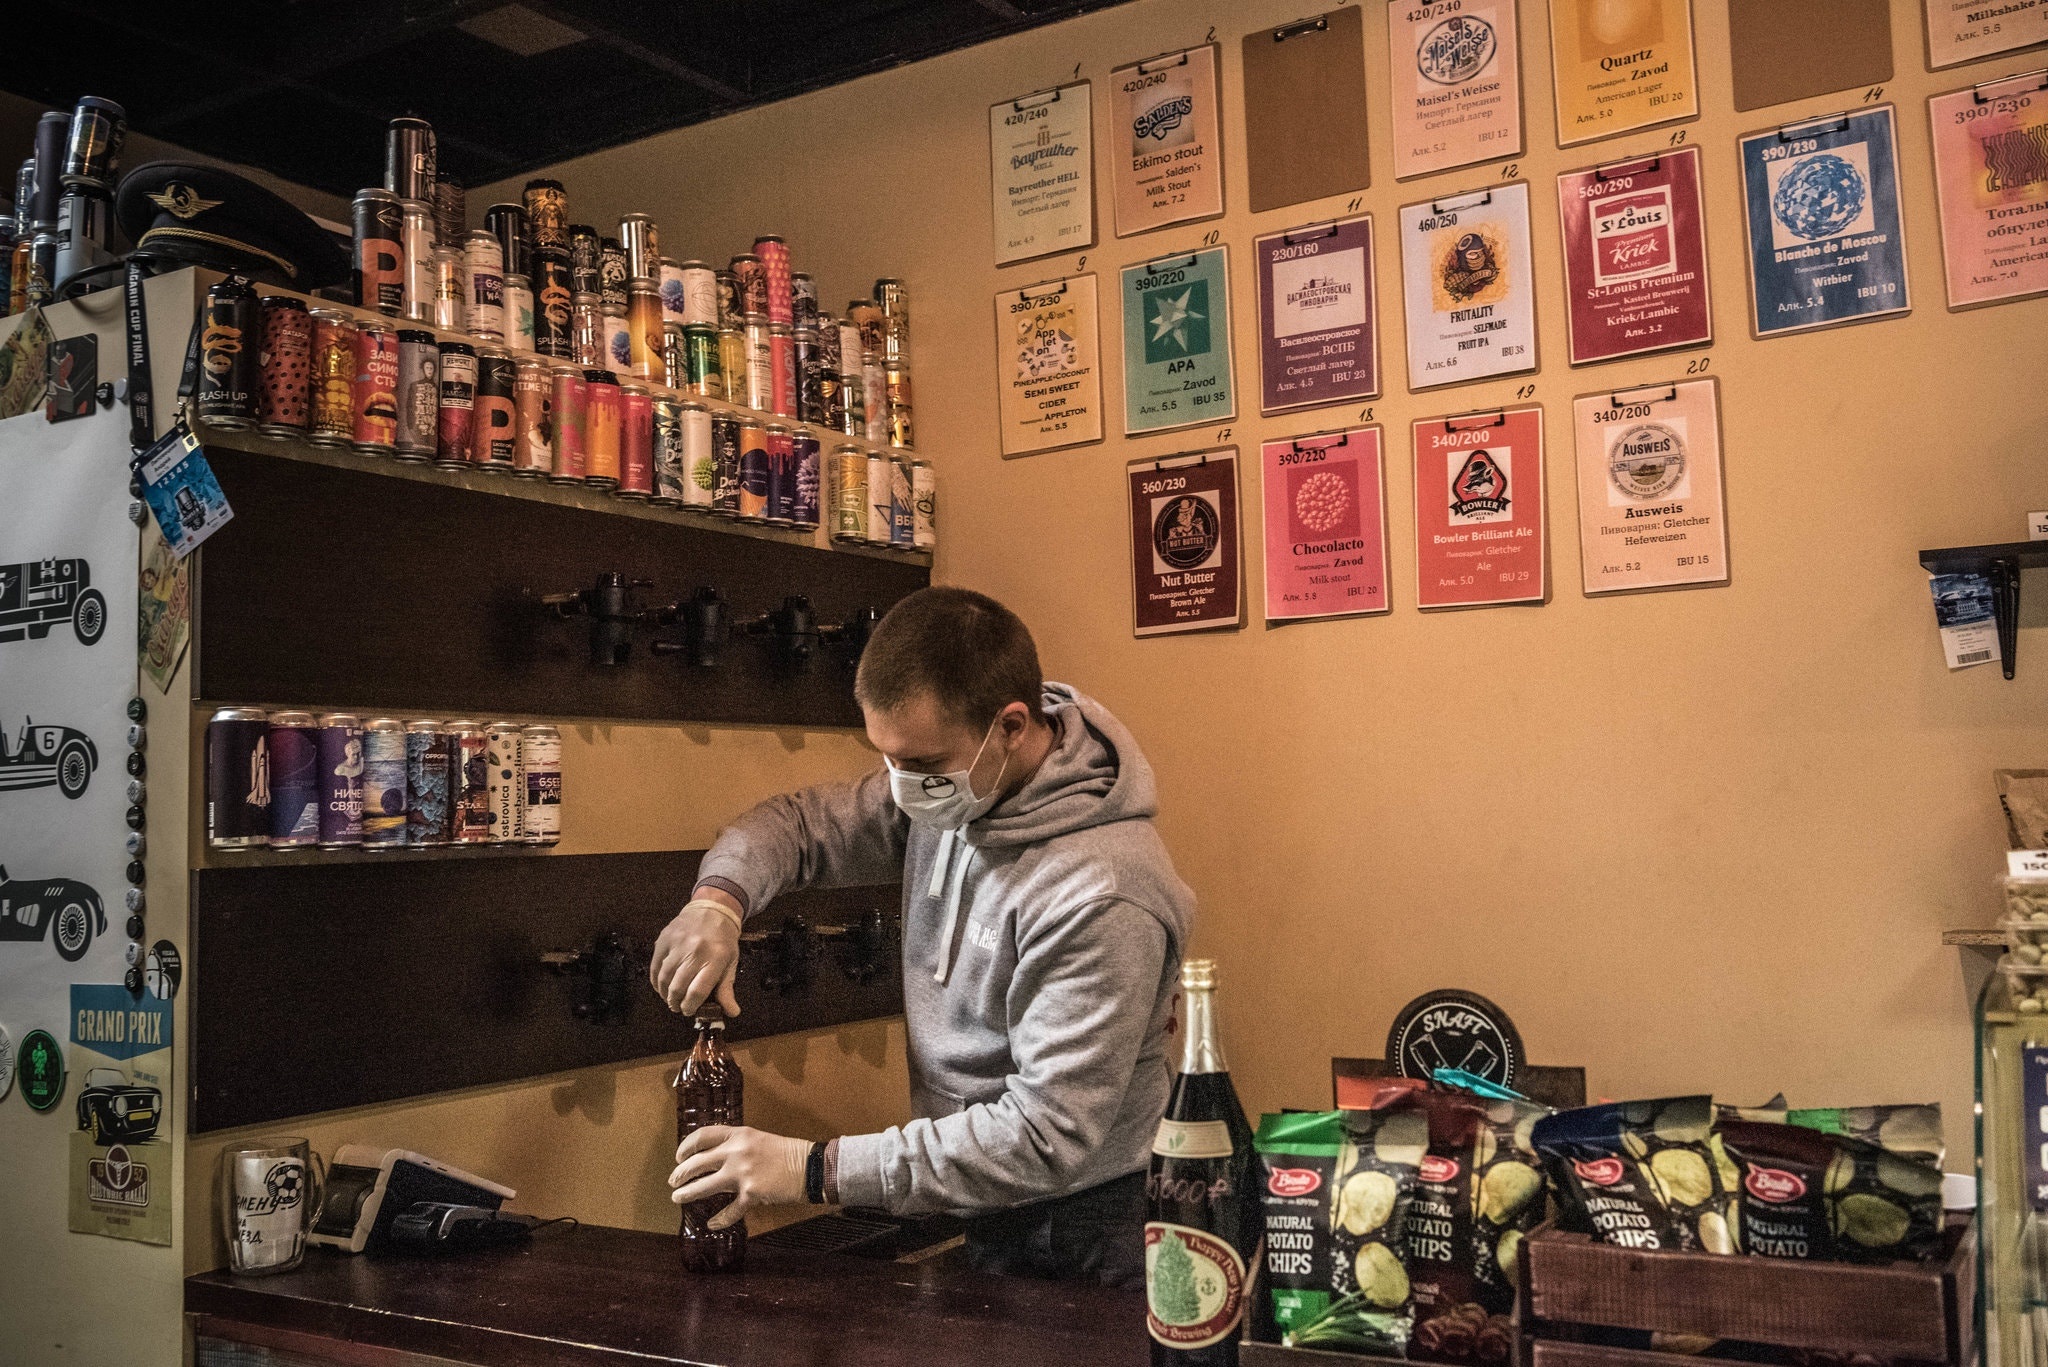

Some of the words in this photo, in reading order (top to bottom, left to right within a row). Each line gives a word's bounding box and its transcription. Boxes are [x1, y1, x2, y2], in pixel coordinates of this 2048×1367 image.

[1407, 1, 1460, 22] 420/240
[1967, 1, 2035, 23] Milkshake
[1983, 24, 2000, 35] 5.5
[1600, 50, 1653, 71] Quartz
[1073, 62, 1081, 79] 1
[1631, 62, 1668, 80] Zavod
[1123, 73, 1166, 93] 420/240
[1416, 91, 1460, 108] Maisel's
[1462, 81, 1499, 97] Weisse
[1595, 89, 1636, 104] American
[1638, 82, 1663, 94] Lager
[1649, 95, 1669, 107] IBU
[1672, 92, 1683, 100] 20
[1863, 87, 1884, 103] 14
[1456, 95, 1501, 111] Германия
[1004, 108, 1048, 126] 420/240
[1425, 115, 1464, 130] Светлый
[1467, 109, 1493, 122] лагер
[1600, 109, 1613, 118] 5.0
[1955, 98, 2031, 125] 390/230
[1478, 130, 1494, 142] IBU
[1498, 129, 1508, 138] 12
[1669, 130, 1686, 146] 13
[1010, 142, 1079, 170] Bayreuther
[1132, 153, 1171, 171] Eskimo
[1175, 145, 1203, 161] stout
[1761, 139, 1818, 161] 390/230
[1165, 163, 1201, 179] Salden's
[1501, 164, 1519, 179] 12
[1008, 177, 1056, 196] Bayreuther
[1058, 171, 1080, 185] HELL
[1146, 185, 1165, 197] Milk
[1168, 178, 1191, 191] Stout
[1579, 177, 1633, 199] 560/290
[1171, 194, 1185, 204] 7.2
[1347, 197, 1363, 212] 11
[1418, 213, 1458, 233] 460/250
[1617, 211, 1662, 229] Louis
[1202, 230, 1220, 246] 10
[1272, 242, 1318, 262] 230/160
[1609, 238, 1659, 265] Kriek
[1774, 245, 1821, 263] Blanche
[1823, 240, 1838, 253] de
[1841, 233, 1887, 251] Moscou
[1837, 251, 1869, 267] Zavod
[1135, 270, 1185, 291] 390/220
[1587, 282, 1638, 300] St-Louis
[1641, 271, 1695, 289] Premium
[1812, 273, 1853, 288] Witbier
[1287, 282, 1351, 305] ВАСИЛЕОСТРОВСКАЯ
[1857, 287, 1877, 299] IBU
[1882, 283, 1896, 293] 10
[1010, 295, 1060, 314] 390/230
[1778, 300, 1803, 313] Алк.
[1807, 295, 1824, 308] 5.4
[129, 308, 141, 332] CUP
[1450, 304, 1494, 323] FRUTALITY
[1606, 305, 1680, 327] Kriek/Lambic
[1035, 329, 1055, 339] App
[1473, 319, 1507, 334] SELFMADE
[1624, 327, 1646, 338] Алк.
[1280, 327, 1361, 348] Василеостровское
[1458, 339, 1477, 351] FRUIT
[1478, 337, 1490, 349] IPA
[132, 334, 144, 366] FINAL
[1322, 341, 1355, 356] ВСПБ
[1502, 347, 1514, 357] IBU
[1167, 359, 1196, 375] APA
[1286, 362, 1326, 376] Светлый
[1328, 359, 1355, 372] лагер
[1686, 357, 1710, 375] 20
[375, 375, 396, 387] СТЬ
[1183, 376, 1216, 391] Zavod
[1332, 371, 1351, 383] IBU
[1354, 370, 1366, 380] 23
[1049, 381, 1080, 395] SWEET
[1276, 382, 1297, 392] Алк.
[1299, 378, 1314, 389] 4.5
[1516, 384, 1536, 400] 19
[232, 392, 248, 401] UP
[1038, 398, 1066, 410] CIDER
[1193, 394, 1211, 405] IBU
[1213, 392, 1226, 402] 35
[1044, 407, 1087, 421] APPLETON
[1162, 402, 1177, 411] 5.5
[1359, 407, 1374, 422] 18
[1593, 405, 1651, 424] 340/200
[1055, 423, 1068, 431] 5.5
[1217, 428, 1232, 443] 17
[1431, 430, 1490, 449] 340/200
[1622, 438, 1671, 457] AUSWEIS
[1278, 449, 1326, 466] 390/220
[1142, 477, 1186, 494] 360/230
[1461, 500, 1499, 513] BOWLER
[1624, 503, 1683, 519] Ausweis
[1600, 522, 1661, 537] Пивоварня:
[1663, 515, 1710, 529] Gletcher
[1433, 531, 1470, 545] Bowler
[1472, 529, 1513, 542] Brilliant
[1515, 527, 1533, 538] Ale
[1624, 531, 1687, 547] Hefeweizen
[1292, 538, 1364, 556] Chocolacto
[1485, 545, 1521, 556] Gletcher
[1333, 556, 1364, 569] Zavod
[1477, 562, 1492, 572] Ale
[1601, 563, 1624, 575] Алк.
[1625, 562, 1641, 572] 5.2
[1677, 557, 1694, 567] IBU
[1697, 555, 1710, 565] 15
[1161, 575, 1182, 588] Nut
[1183, 571, 1216, 586] Butter
[1309, 575, 1330, 585] Milk
[1331, 573, 1351, 583] stout
[1460, 575, 1474, 586] 5.0
[1517, 571, 1529, 581] 29
[1347, 587, 1365, 597] IBU
[1367, 586, 1378, 595] 20
[1170, 598, 1192, 608] Brown
[1193, 596, 1206, 605] Ale
[43, 730, 55, 750] 6
[502, 785, 510, 838] ostrovica
[78, 1010, 125, 1042] GRAND
[128, 1012, 162, 1045] PRIX
[1585, 1197, 1644, 1214] NATURAL
[1266, 1216, 1314, 1230] NATURAL
[1592, 1212, 1650, 1232] POTATO
[1268, 1232, 1314, 1250] POTATO
[1749, 1231, 1808, 1257] POTATO
[1268, 1252, 1312, 1274] CHIPS
